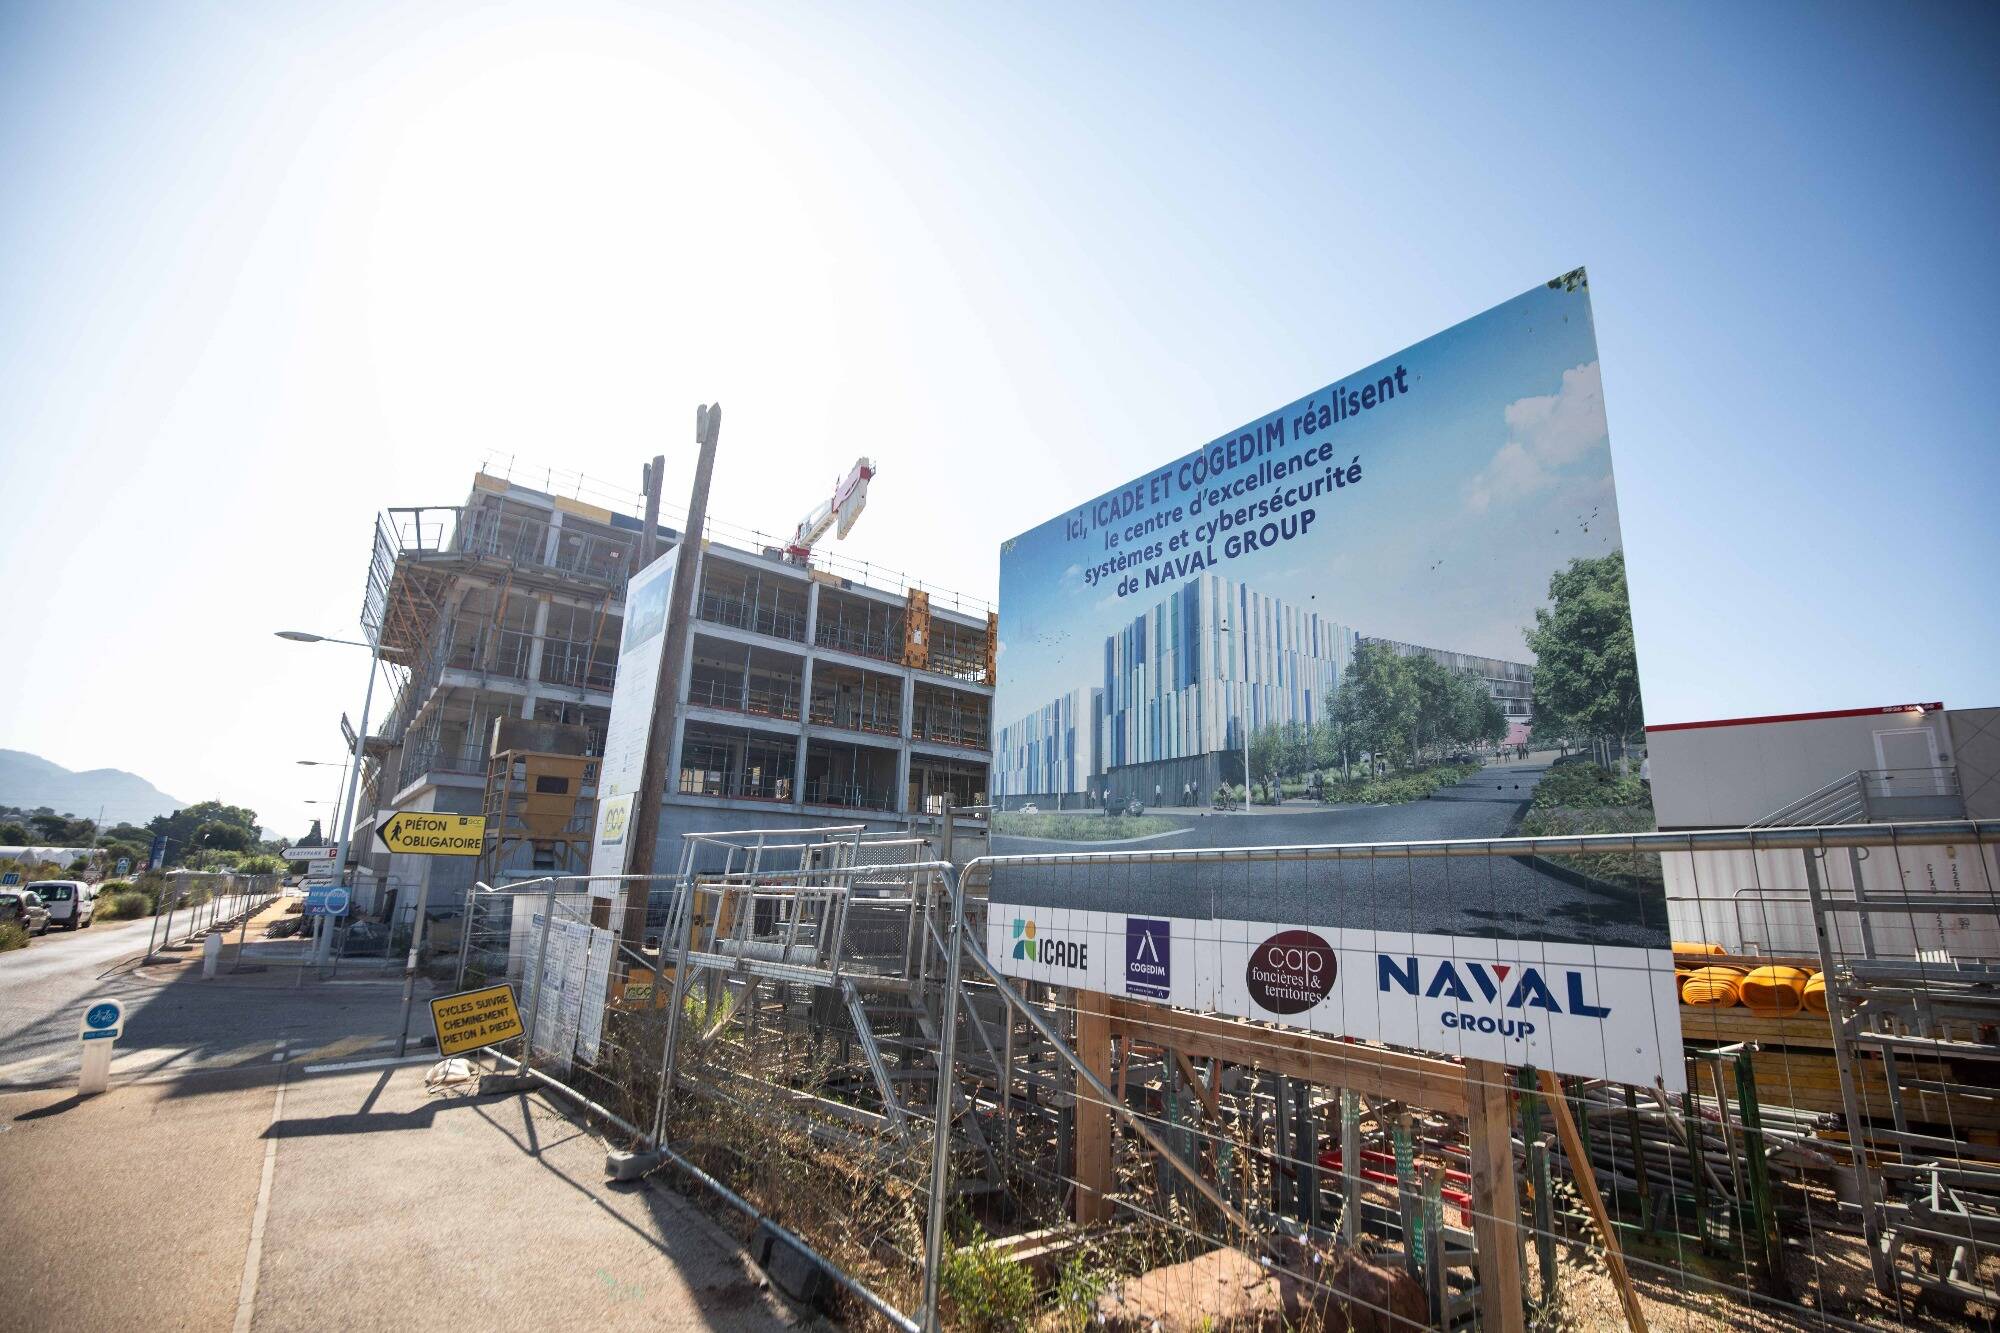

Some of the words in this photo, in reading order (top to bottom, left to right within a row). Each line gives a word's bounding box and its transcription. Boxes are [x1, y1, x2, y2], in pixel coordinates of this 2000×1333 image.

[1066, 511, 1088, 542] Ici,
[1092, 484, 1145, 529] ICADE
[1150, 471, 1173, 505] ET
[1178, 417, 1285, 491] COGEDIM
[1293, 364, 1410, 441] réalisent
[1105, 530, 1119, 551] le
[1124, 506, 1183, 541] centre
[1189, 442, 1334, 516] d'excellence
[1084, 539, 1163, 584] systèmes
[1168, 524, 1190, 550] et
[1194, 455, 1363, 543] cybersécurité
[1117, 575, 1139, 598] de
[1145, 545, 1218, 590] NAVAL
[1224, 509, 1317, 559] GROUP
[405, 817, 447, 831] PIÉTON
[402, 835, 481, 849] OBLIGATOIRE
[1039, 938, 1088, 970] ICADE
[1268, 947, 1323, 987] cap
[1130, 962, 1166, 976] COGEDIM
[1252, 966, 1304, 987] foncières
[1310, 977, 1321, 989] &
[1265, 985, 1323, 1003] territoires
[1378, 954, 1612, 1019] NAVAL
[438, 1002, 474, 1017] CYCLES
[475, 995, 509, 1009] SUIVRE
[443, 1007, 509, 1030] CHEMINEMENT
[443, 1029, 477, 1044] PIETON
[488, 1020, 516, 1034] PIEDS
[1440, 1011, 1535, 1039] GROUP
